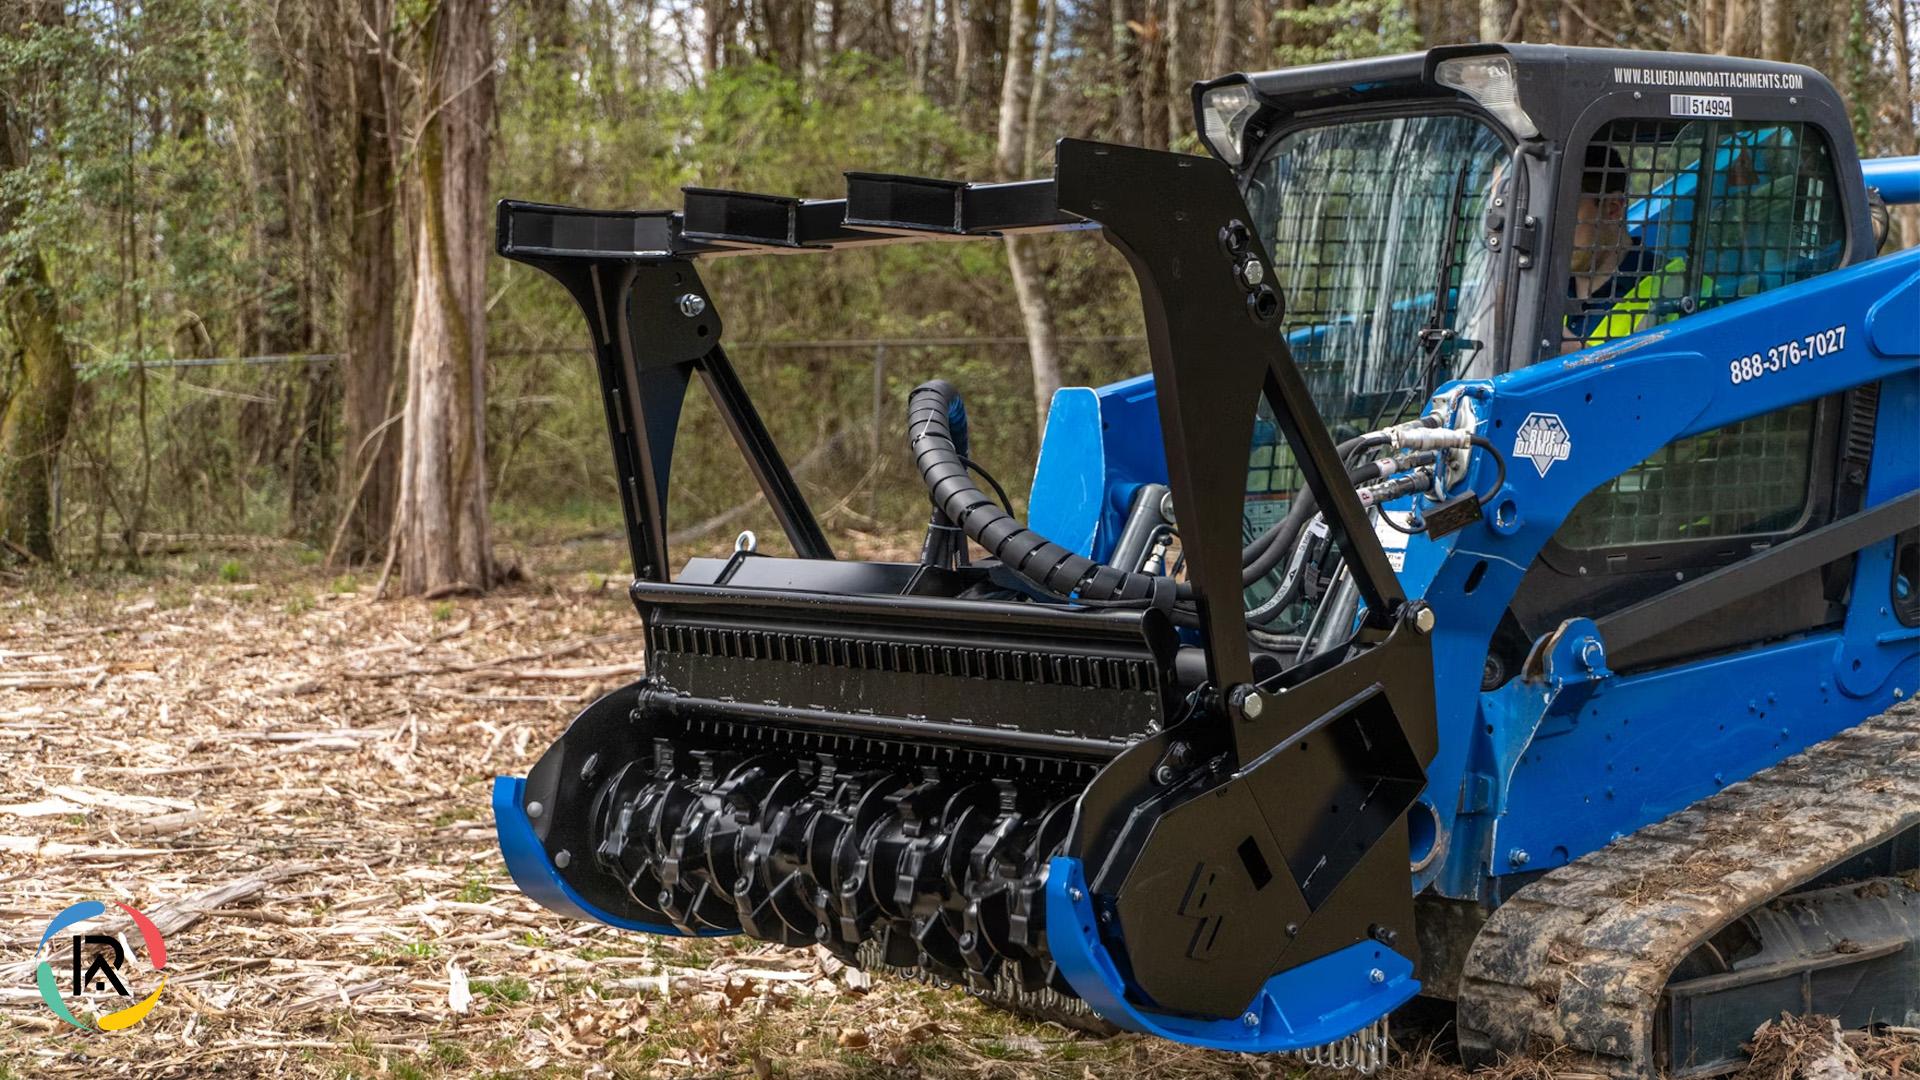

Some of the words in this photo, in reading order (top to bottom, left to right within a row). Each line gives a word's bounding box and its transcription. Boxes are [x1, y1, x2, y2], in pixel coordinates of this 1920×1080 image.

[1613, 67, 1803, 90] WWW.BLUEDIAMONDATTACHMENTS.COM
[1692, 99, 1731, 115] 514994
[1730, 325, 1846, 384] 888-376-7027
[1529, 429, 1557, 443] BLUE
[1515, 440, 1569, 458] DIAMOND
